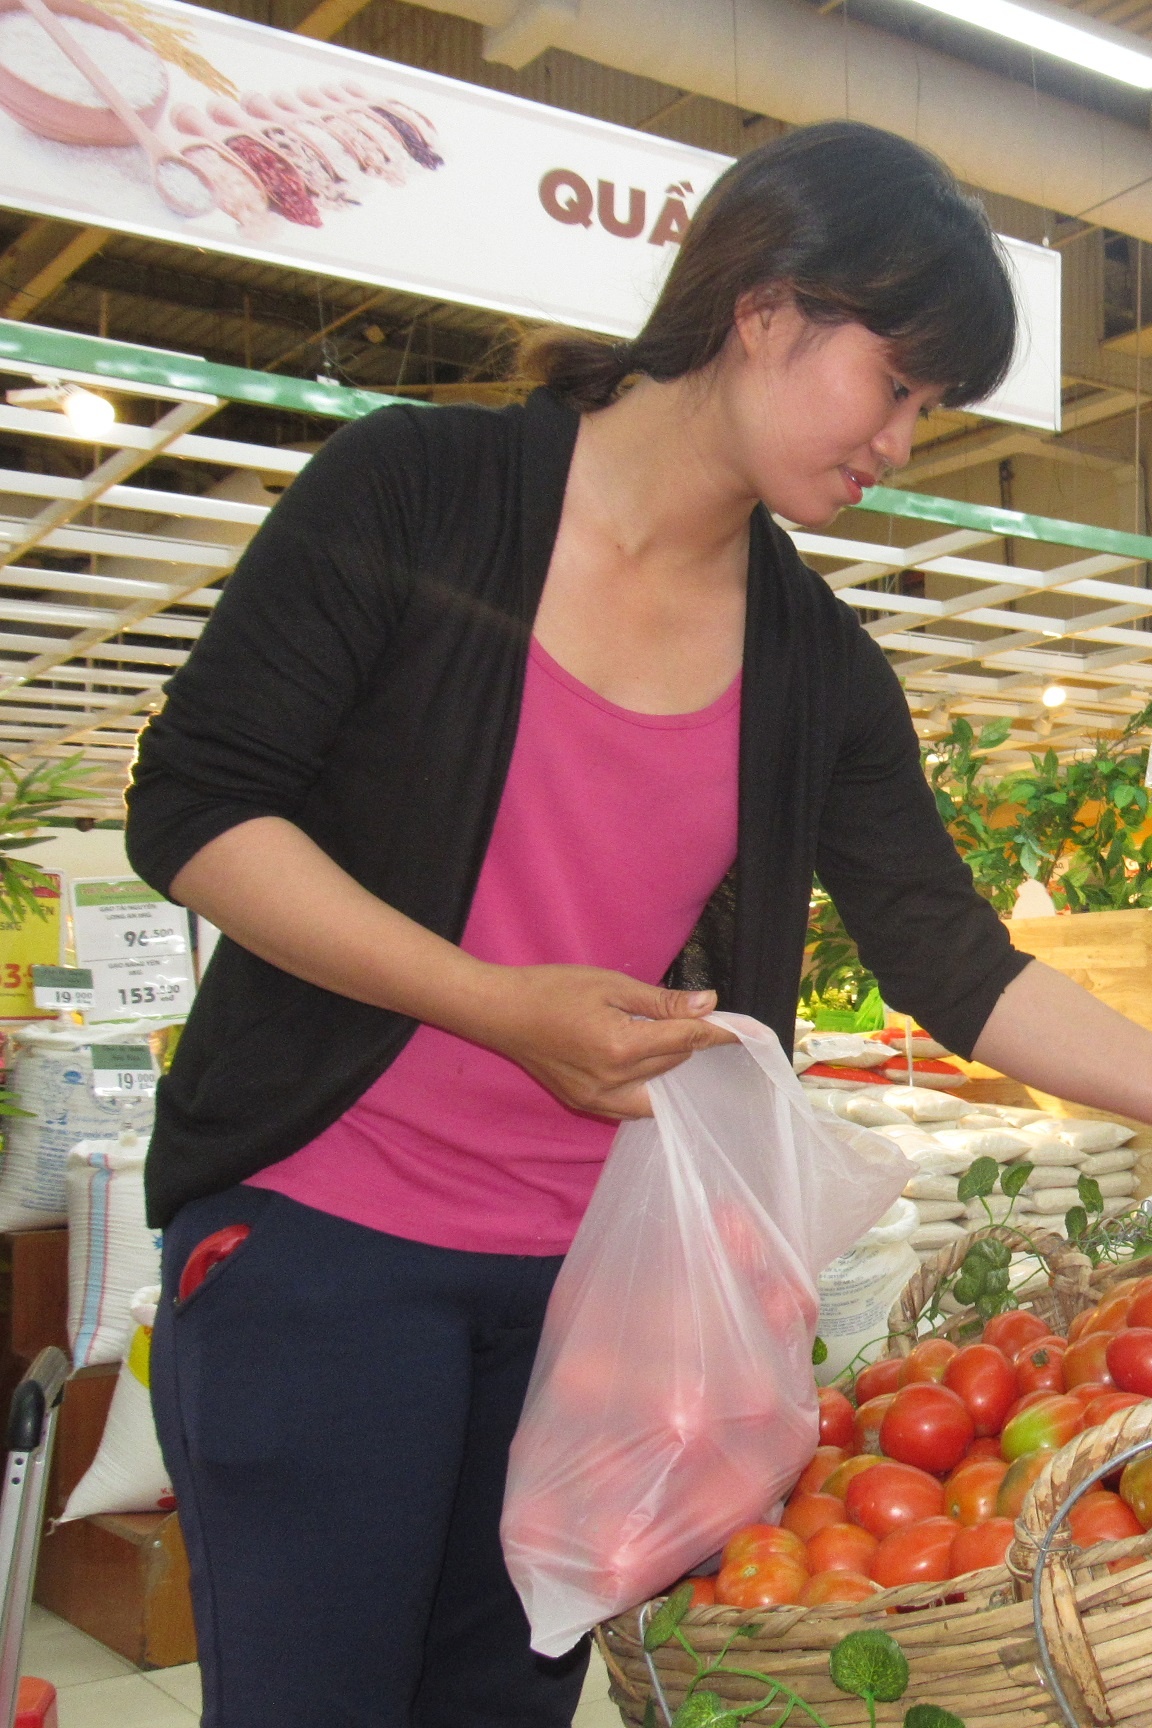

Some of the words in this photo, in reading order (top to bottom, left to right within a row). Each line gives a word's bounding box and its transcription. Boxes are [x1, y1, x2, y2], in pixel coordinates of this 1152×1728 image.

[124, 930, 149, 947] 96
[55, 991, 71, 1004] 19
[118, 987, 156, 1005] 153
[117, 1072, 133, 1089] 19
